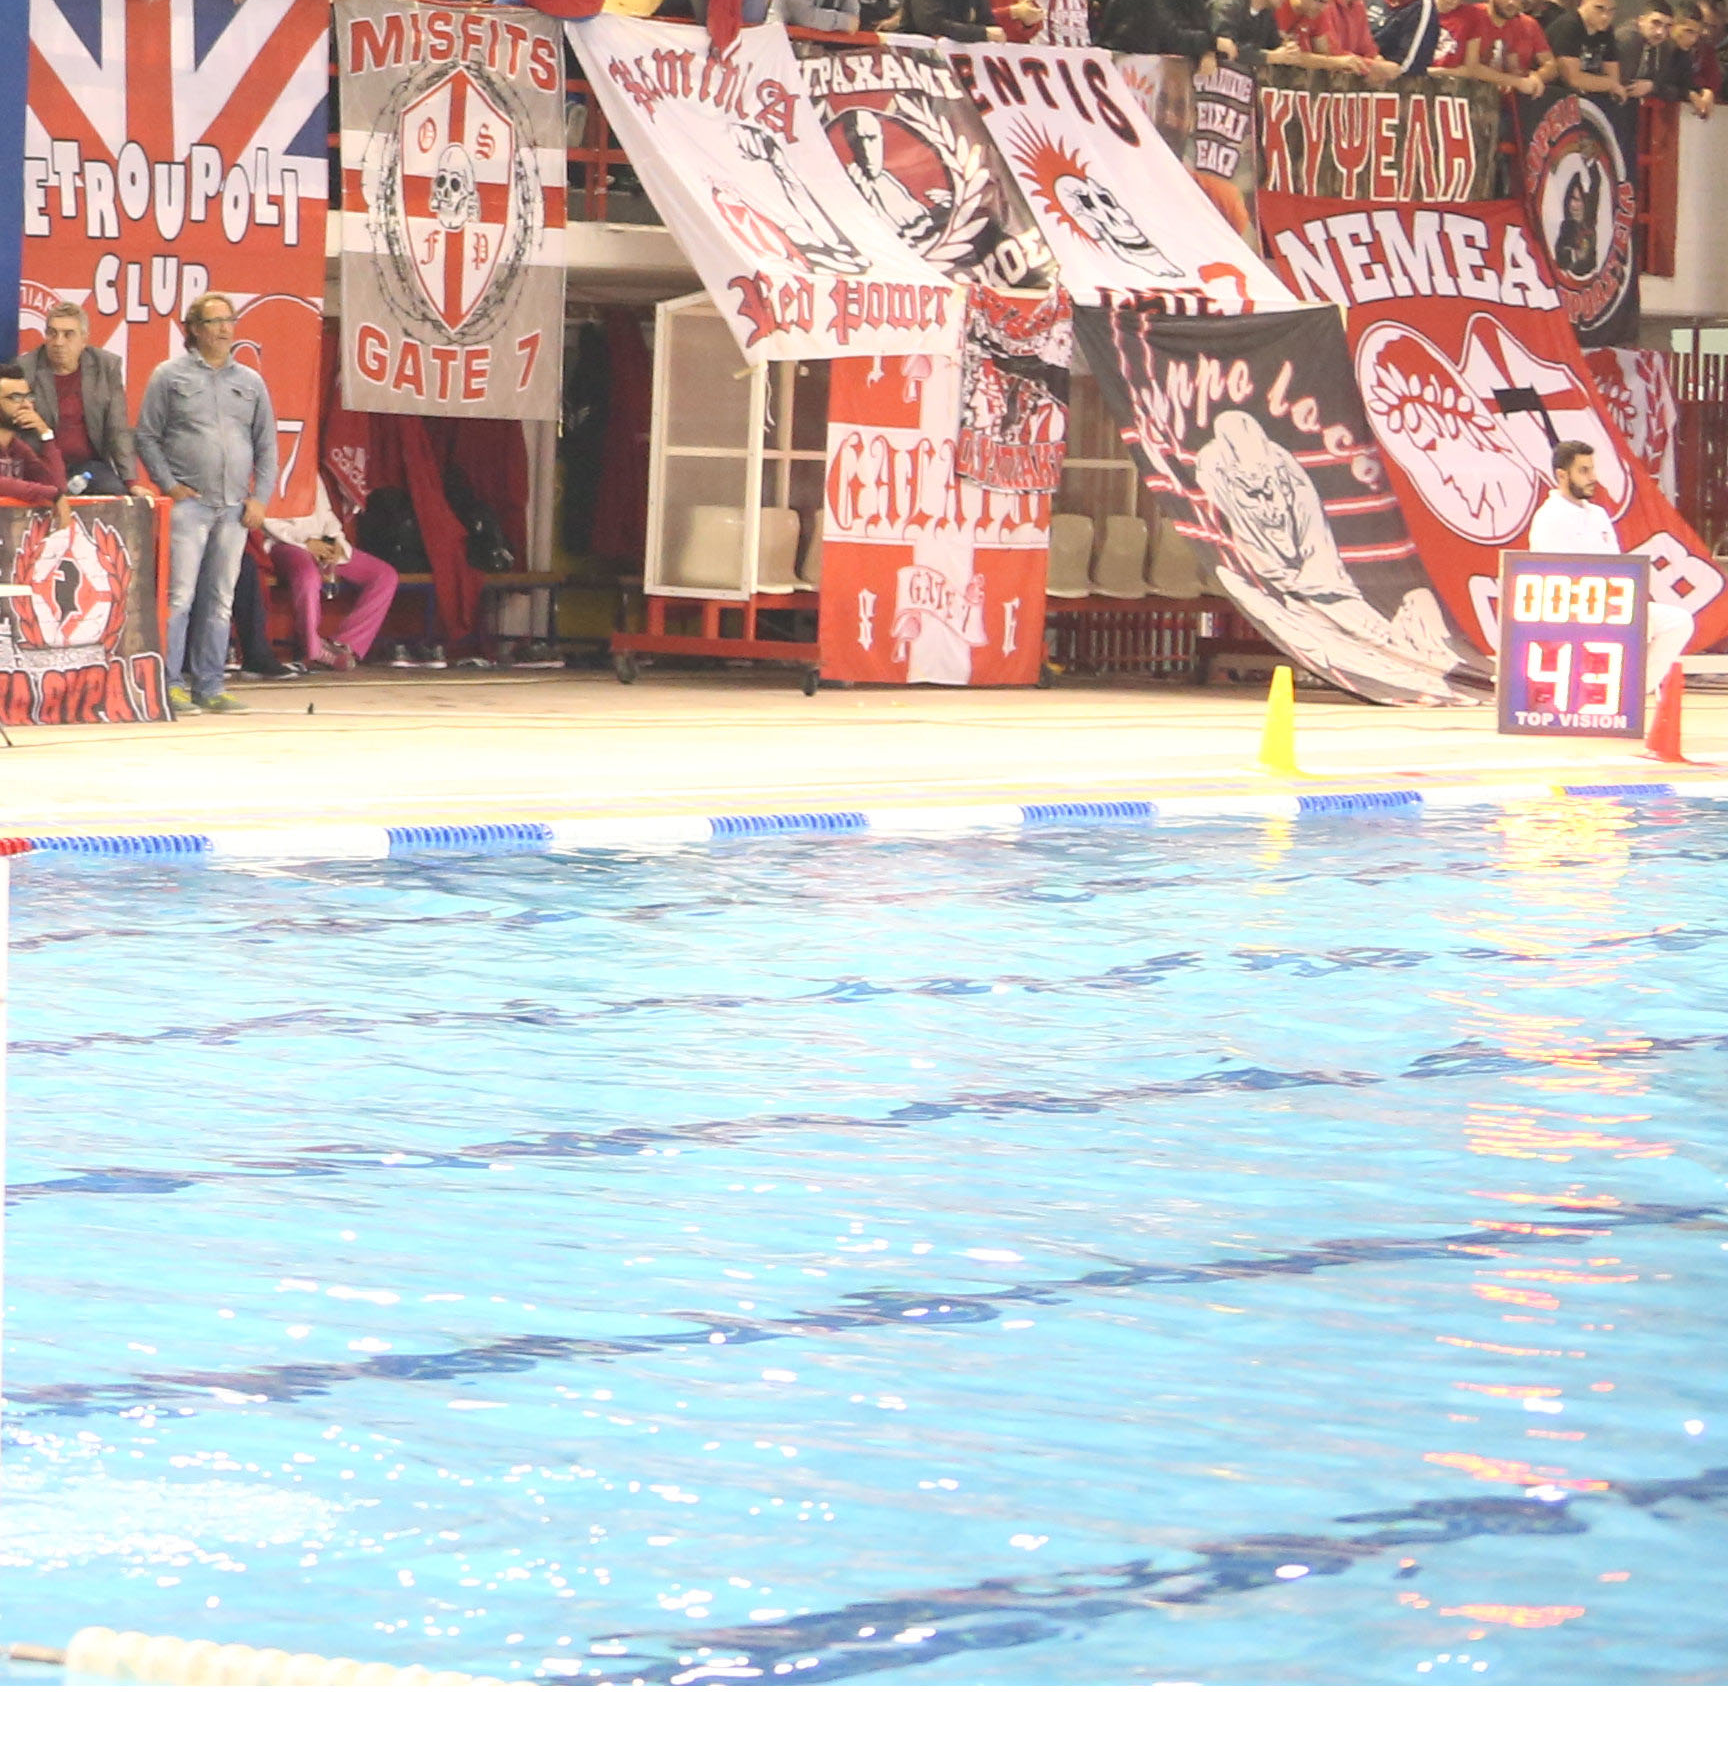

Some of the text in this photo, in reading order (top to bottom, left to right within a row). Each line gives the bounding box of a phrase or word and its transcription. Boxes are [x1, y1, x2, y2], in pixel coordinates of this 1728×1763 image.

[349, 10, 559, 93] MISFITS
[1261, 87, 1477, 204] ΚΥΨΕΛΗ
[24, 139, 300, 247] ETROUPOLI
[1273, 209, 1561, 310] NEMEA
[355, 321, 542, 404] GATE 7
[1513, 574, 1635, 626] 00:03
[1526, 640, 1625, 716] 43
[1515, 711, 1628, 729] TOP VISION
